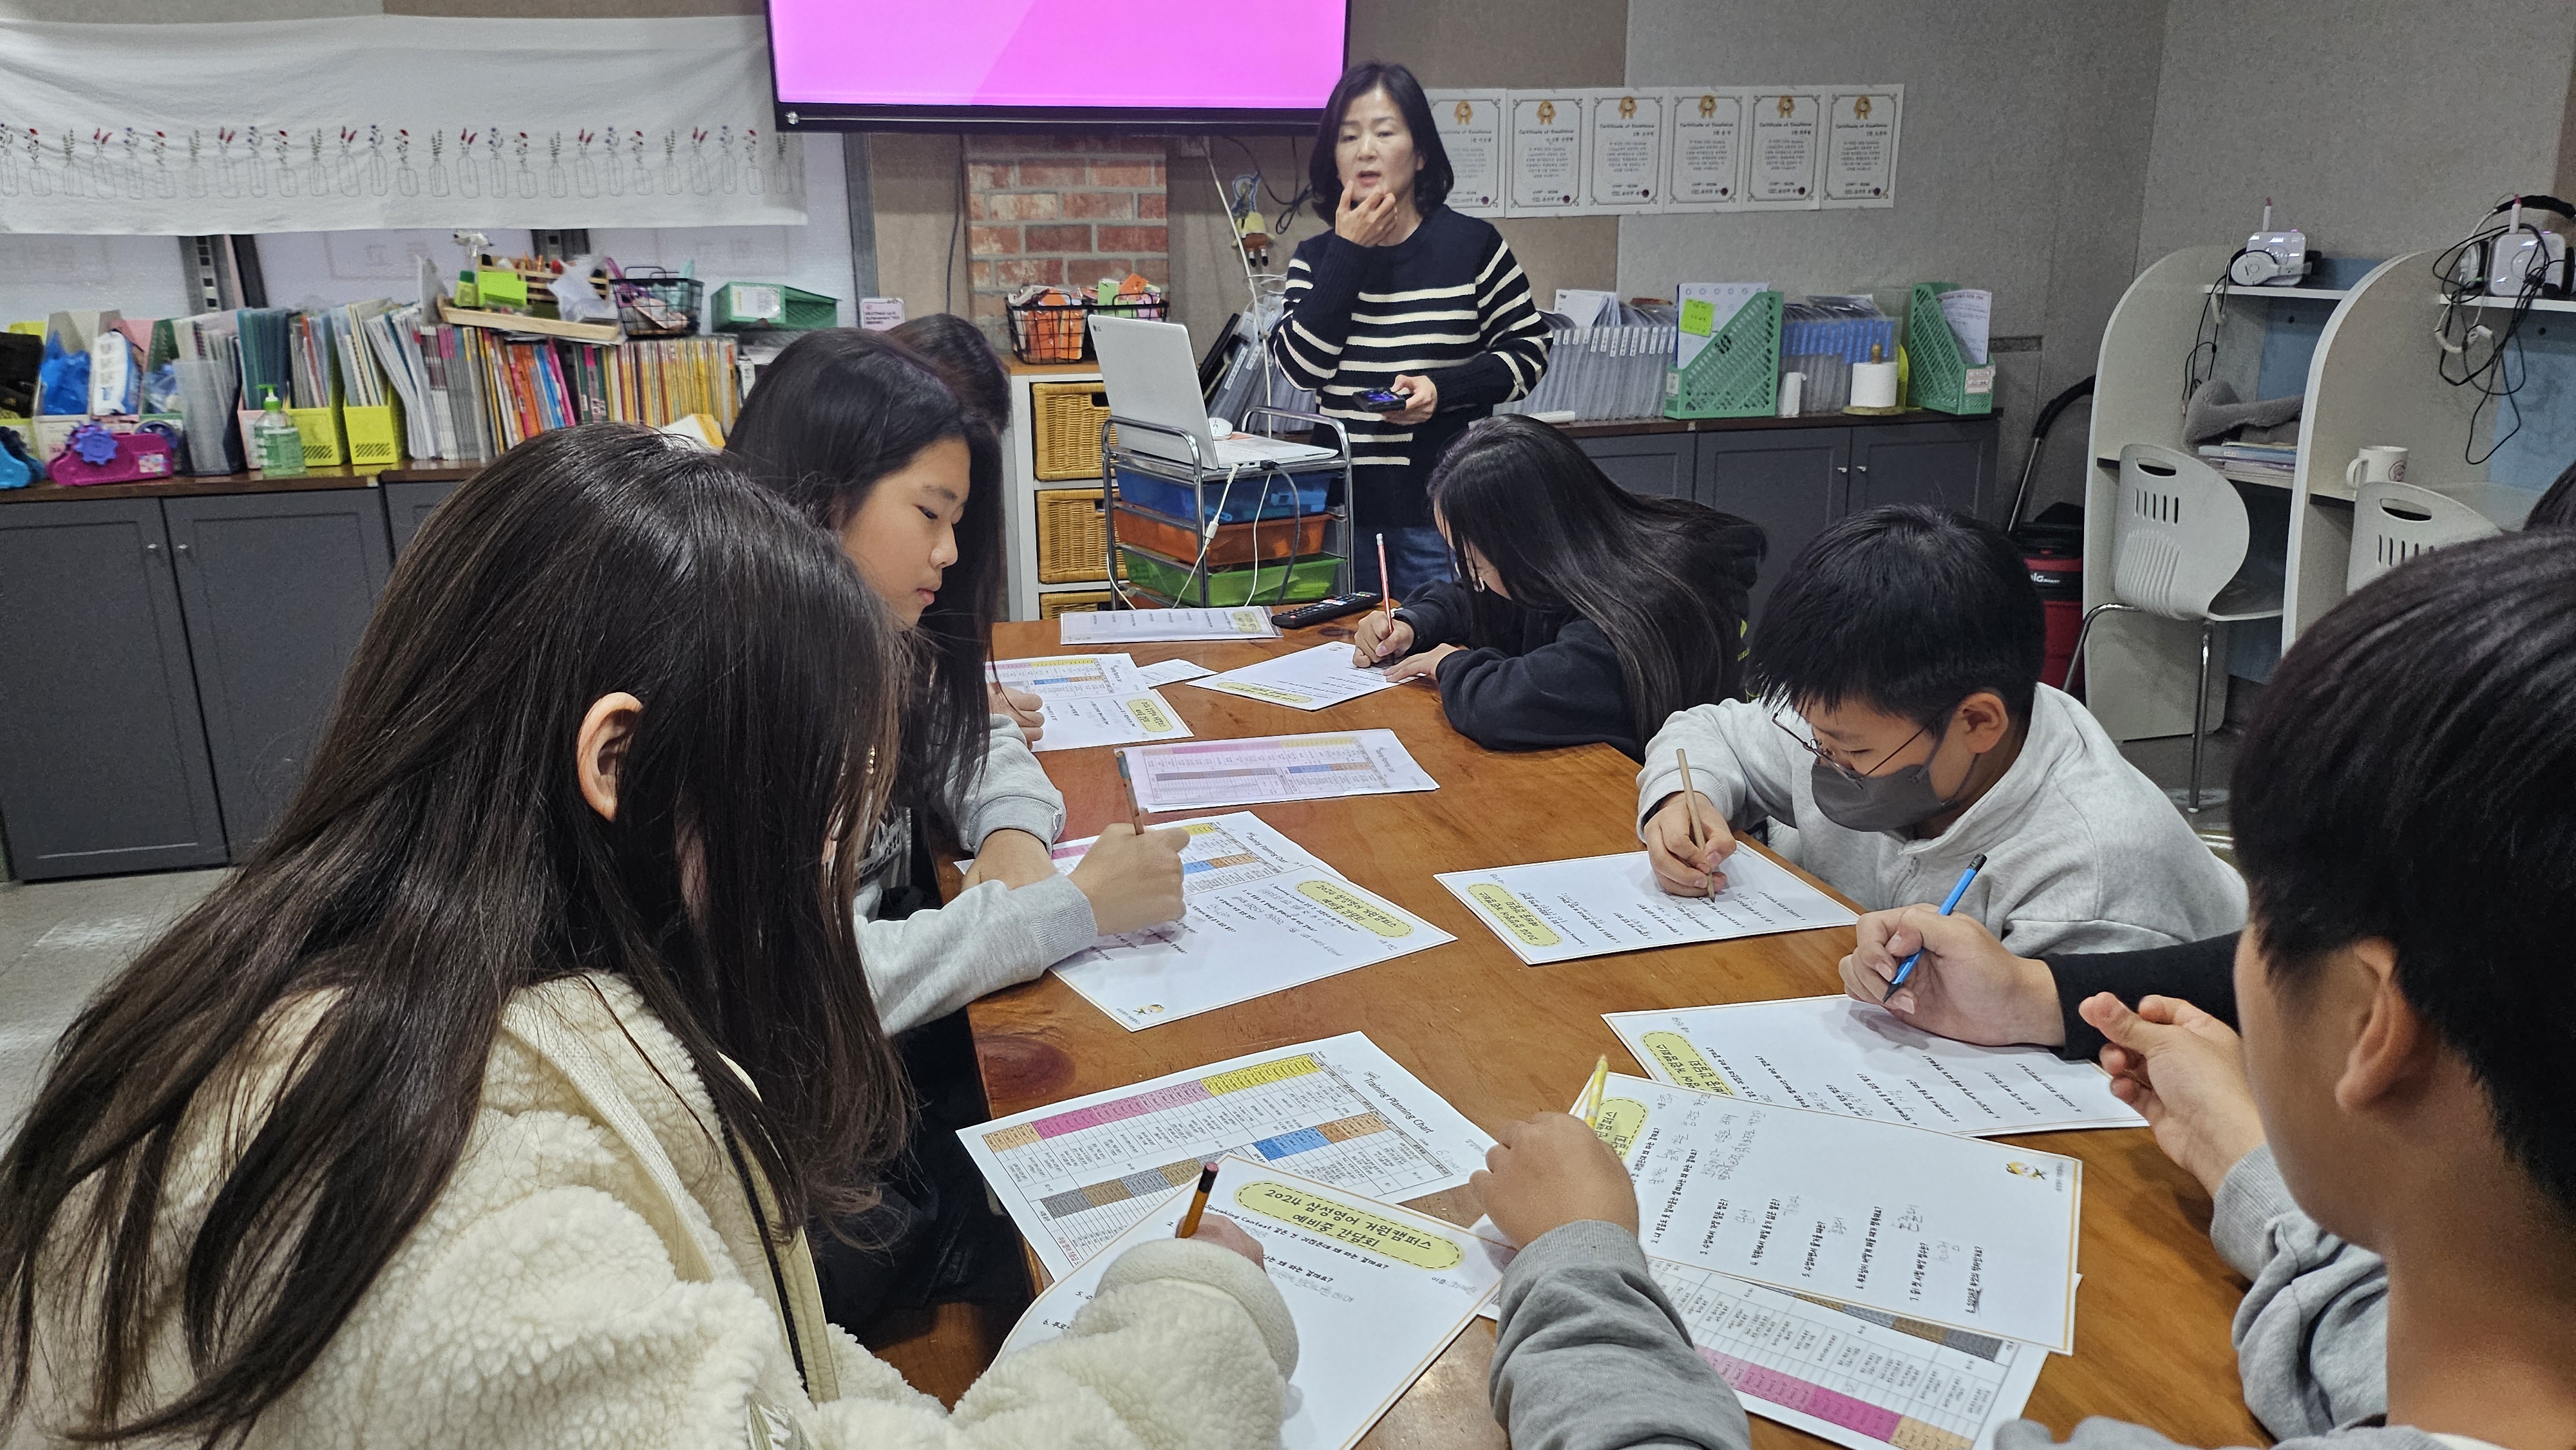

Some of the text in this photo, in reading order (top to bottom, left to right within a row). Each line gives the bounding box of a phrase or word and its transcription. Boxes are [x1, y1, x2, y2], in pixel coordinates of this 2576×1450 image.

[1656, 1044, 1686, 1074] 거원캠퍼스
[1687, 1060, 1714, 1079] 간담회
[1364, 1078, 1434, 1133] Training Planning Chart
[1717, 1199, 1728, 1210] 점은?
[1768, 1199, 1780, 1210] 말은?
[1264, 1189, 1431, 1250] 2024 삼성영어 거원캠퍼스
[1713, 1211, 1725, 1219] 힘든
[1765, 1211, 1776, 1220] 싫은
[1293, 1214, 1380, 1247] 예비중 간담회
[1710, 1220, 1721, 1229] 가장
[1762, 1220, 1772, 1230] 듣기
[1815, 1221, 1826, 1234] 때는?
[1202, 1204, 1239, 1219] Speaking
[1242, 1217, 1271, 1230] Contest
[1360, 1257, 1388, 1269] 걸까요?
[1703, 1230, 1716, 1249] 수업에서
[1759, 1230, 1770, 1240] 제일
[1810, 1234, 1823, 1247] 즐거울
[1751, 1240, 1765, 1258] 학원에서
[1804, 1248, 1817, 1271] 수업하면서
